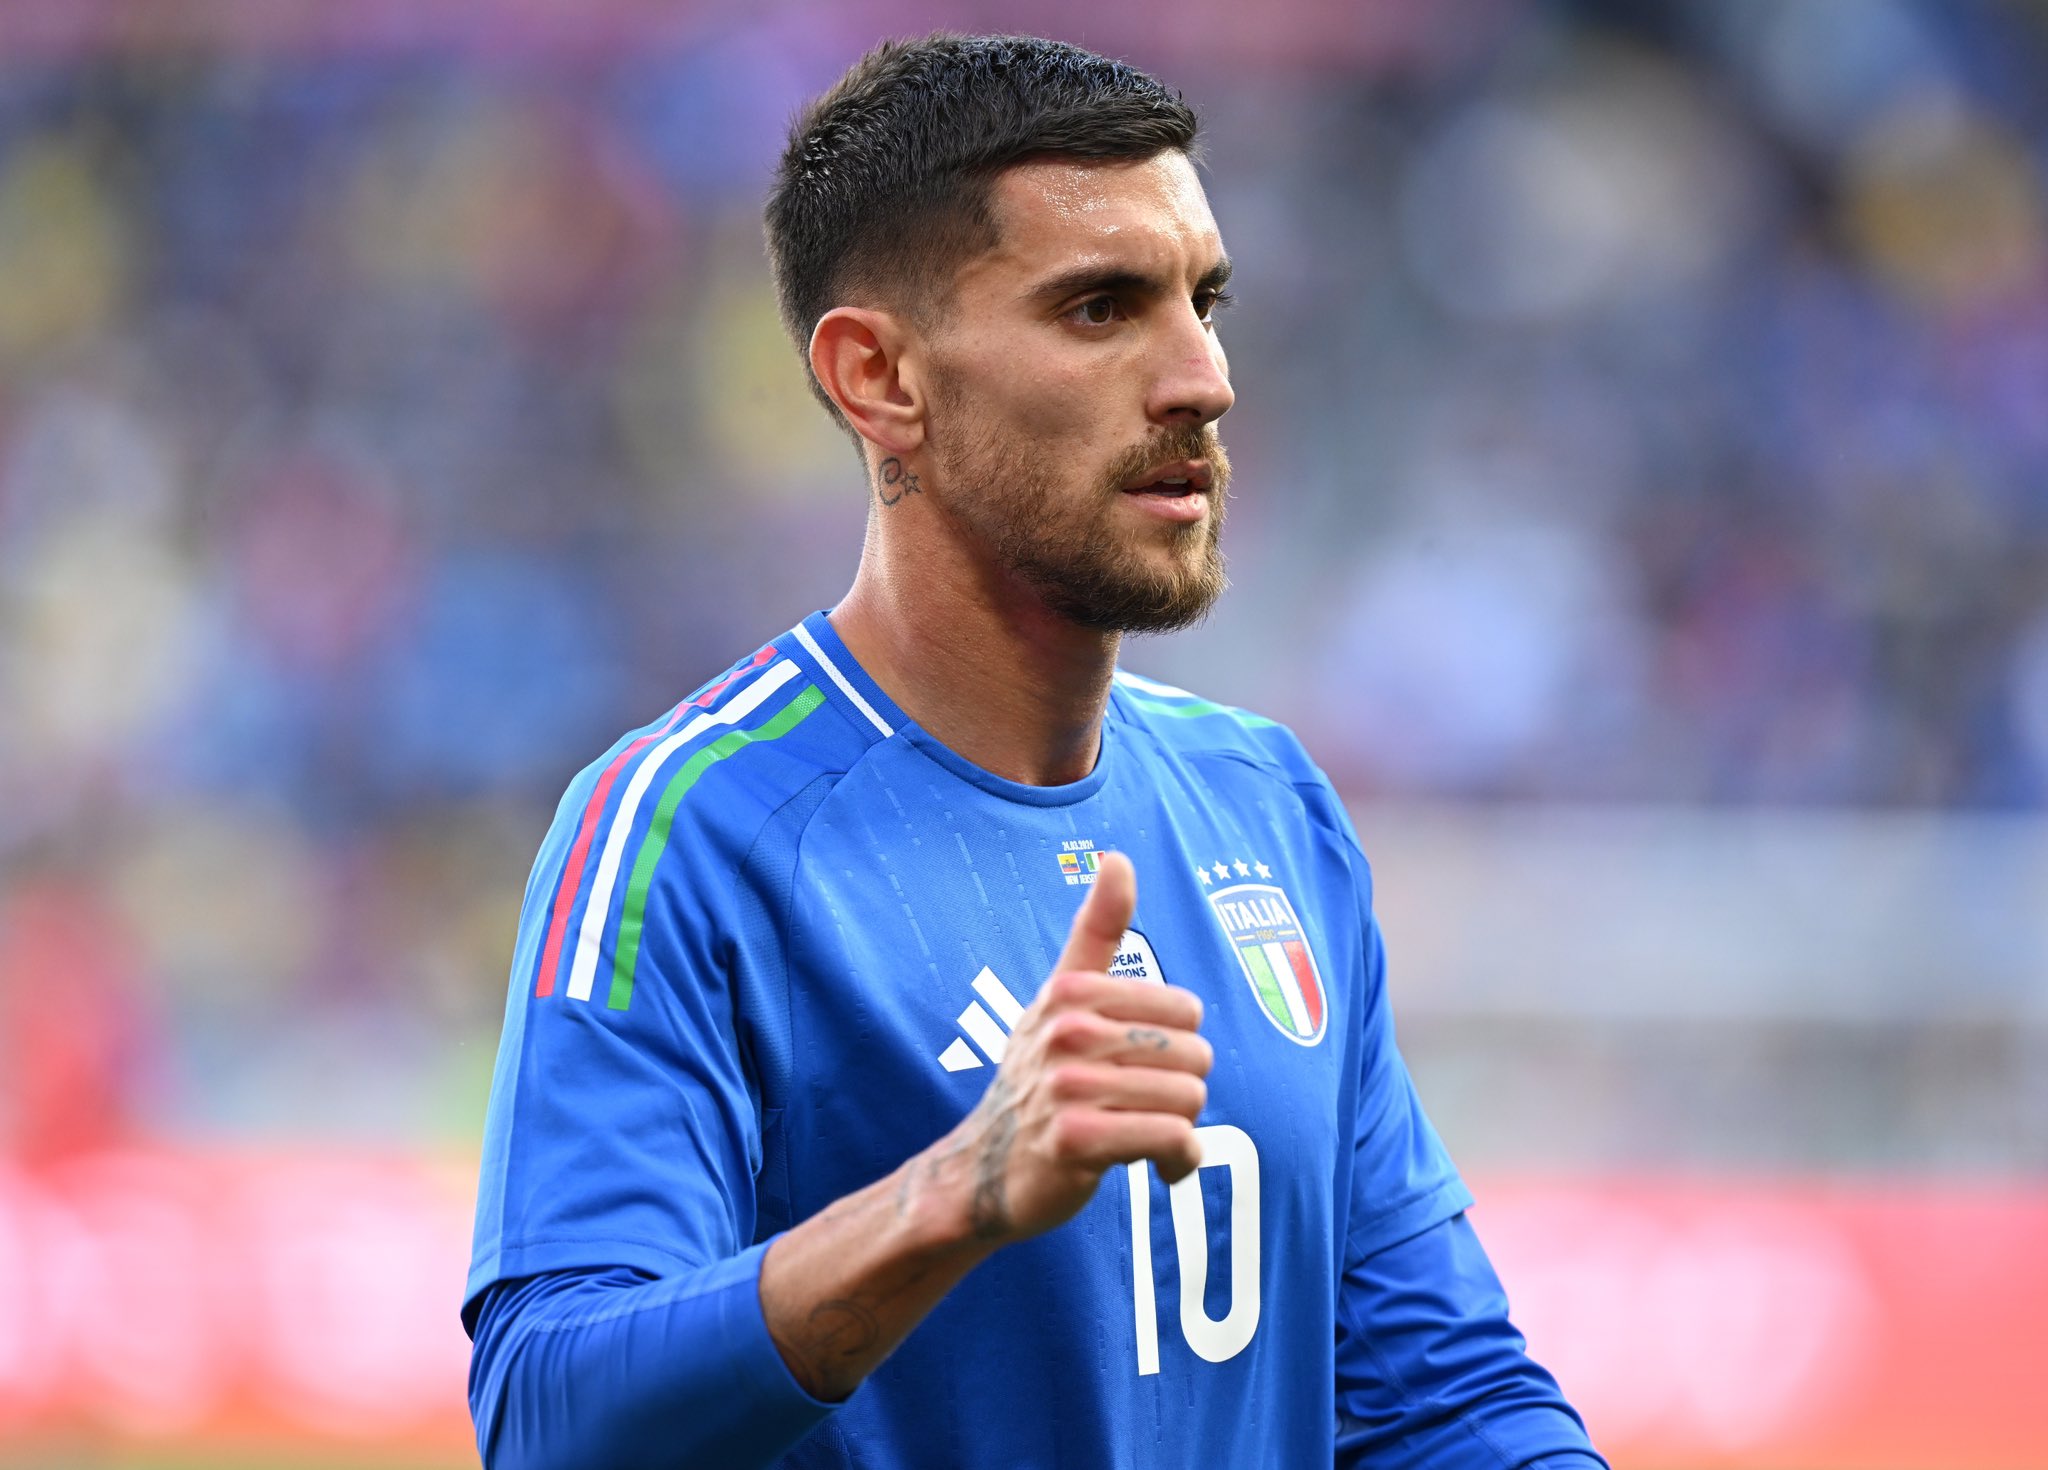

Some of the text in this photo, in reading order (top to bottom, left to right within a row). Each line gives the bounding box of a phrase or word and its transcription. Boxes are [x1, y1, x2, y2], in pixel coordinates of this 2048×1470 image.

[1064, 874, 1079, 885] NEW
[1217, 897, 1292, 931] ITALIA
[1127, 1124, 1261, 1376] 10
